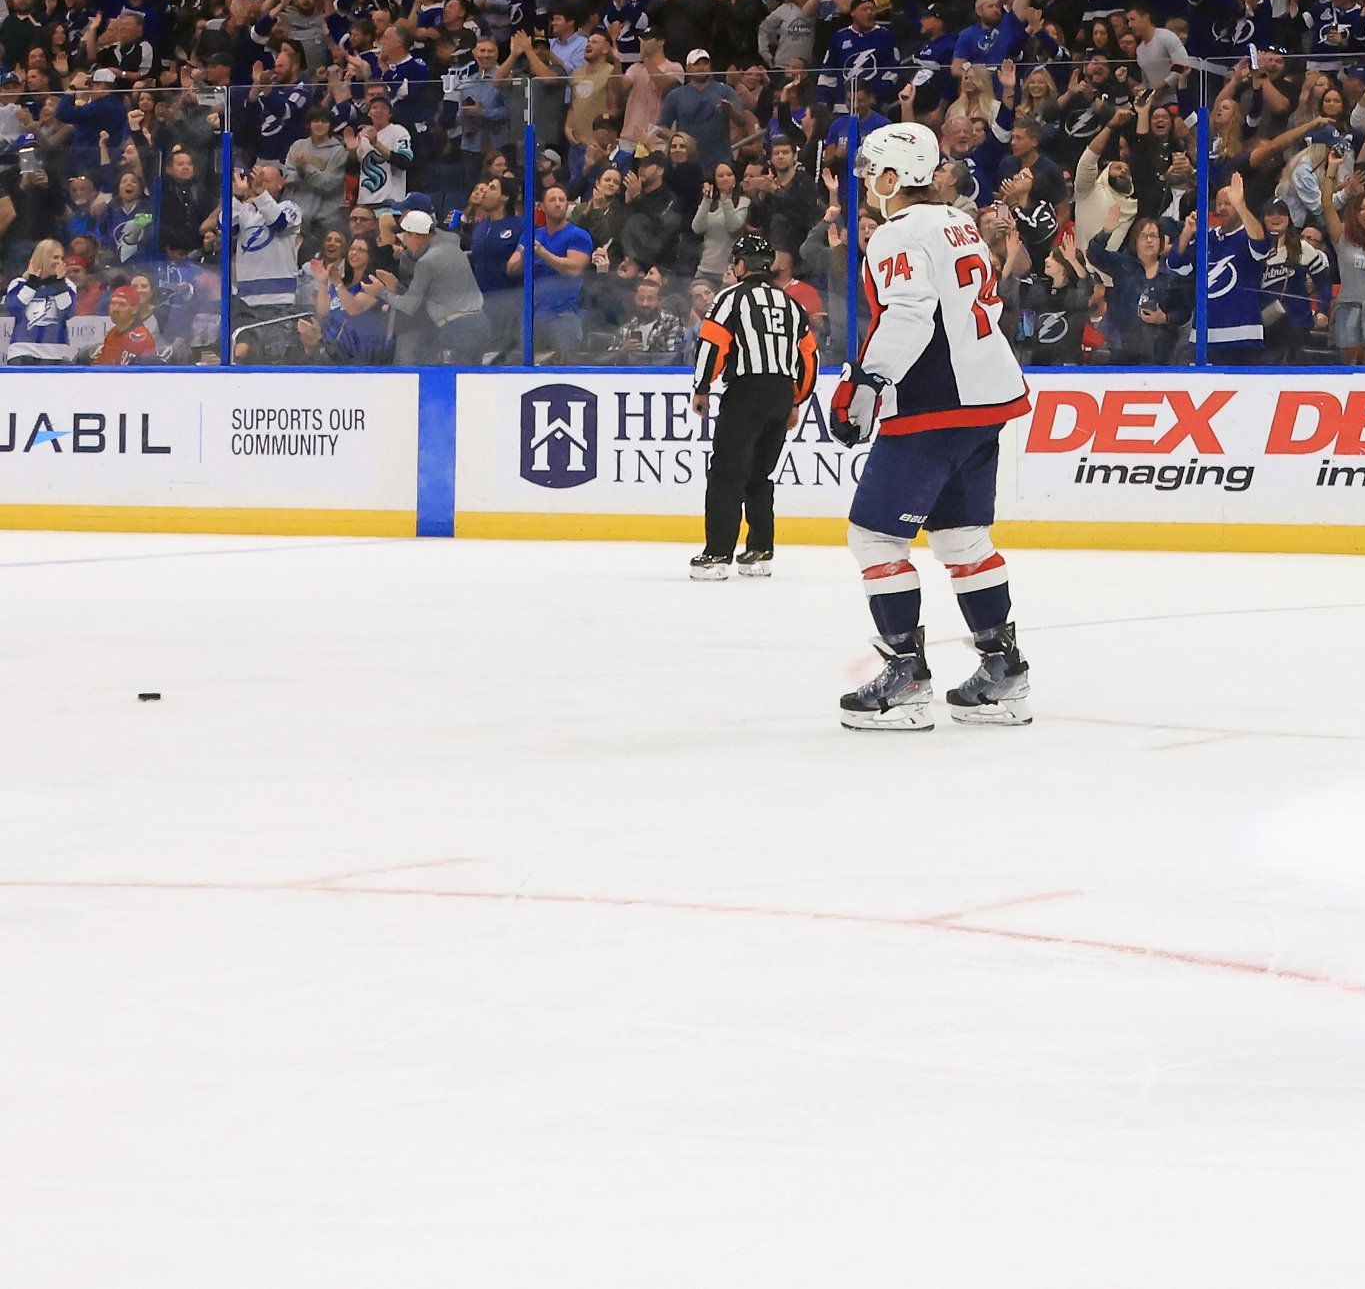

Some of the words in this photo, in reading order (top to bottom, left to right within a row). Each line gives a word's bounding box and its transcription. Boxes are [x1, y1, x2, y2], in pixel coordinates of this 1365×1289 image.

[878, 251, 914, 289] 74
[762, 306, 787, 335] 12
[0, 412, 171, 454] JABIL
[231, 408, 323, 431] SUPPORTS
[329, 408, 366, 431] OUR
[1025, 390, 1240, 455] DEX
[231, 433, 339, 457] COMMUNITY
[1074, 457, 1256, 491] imaging
